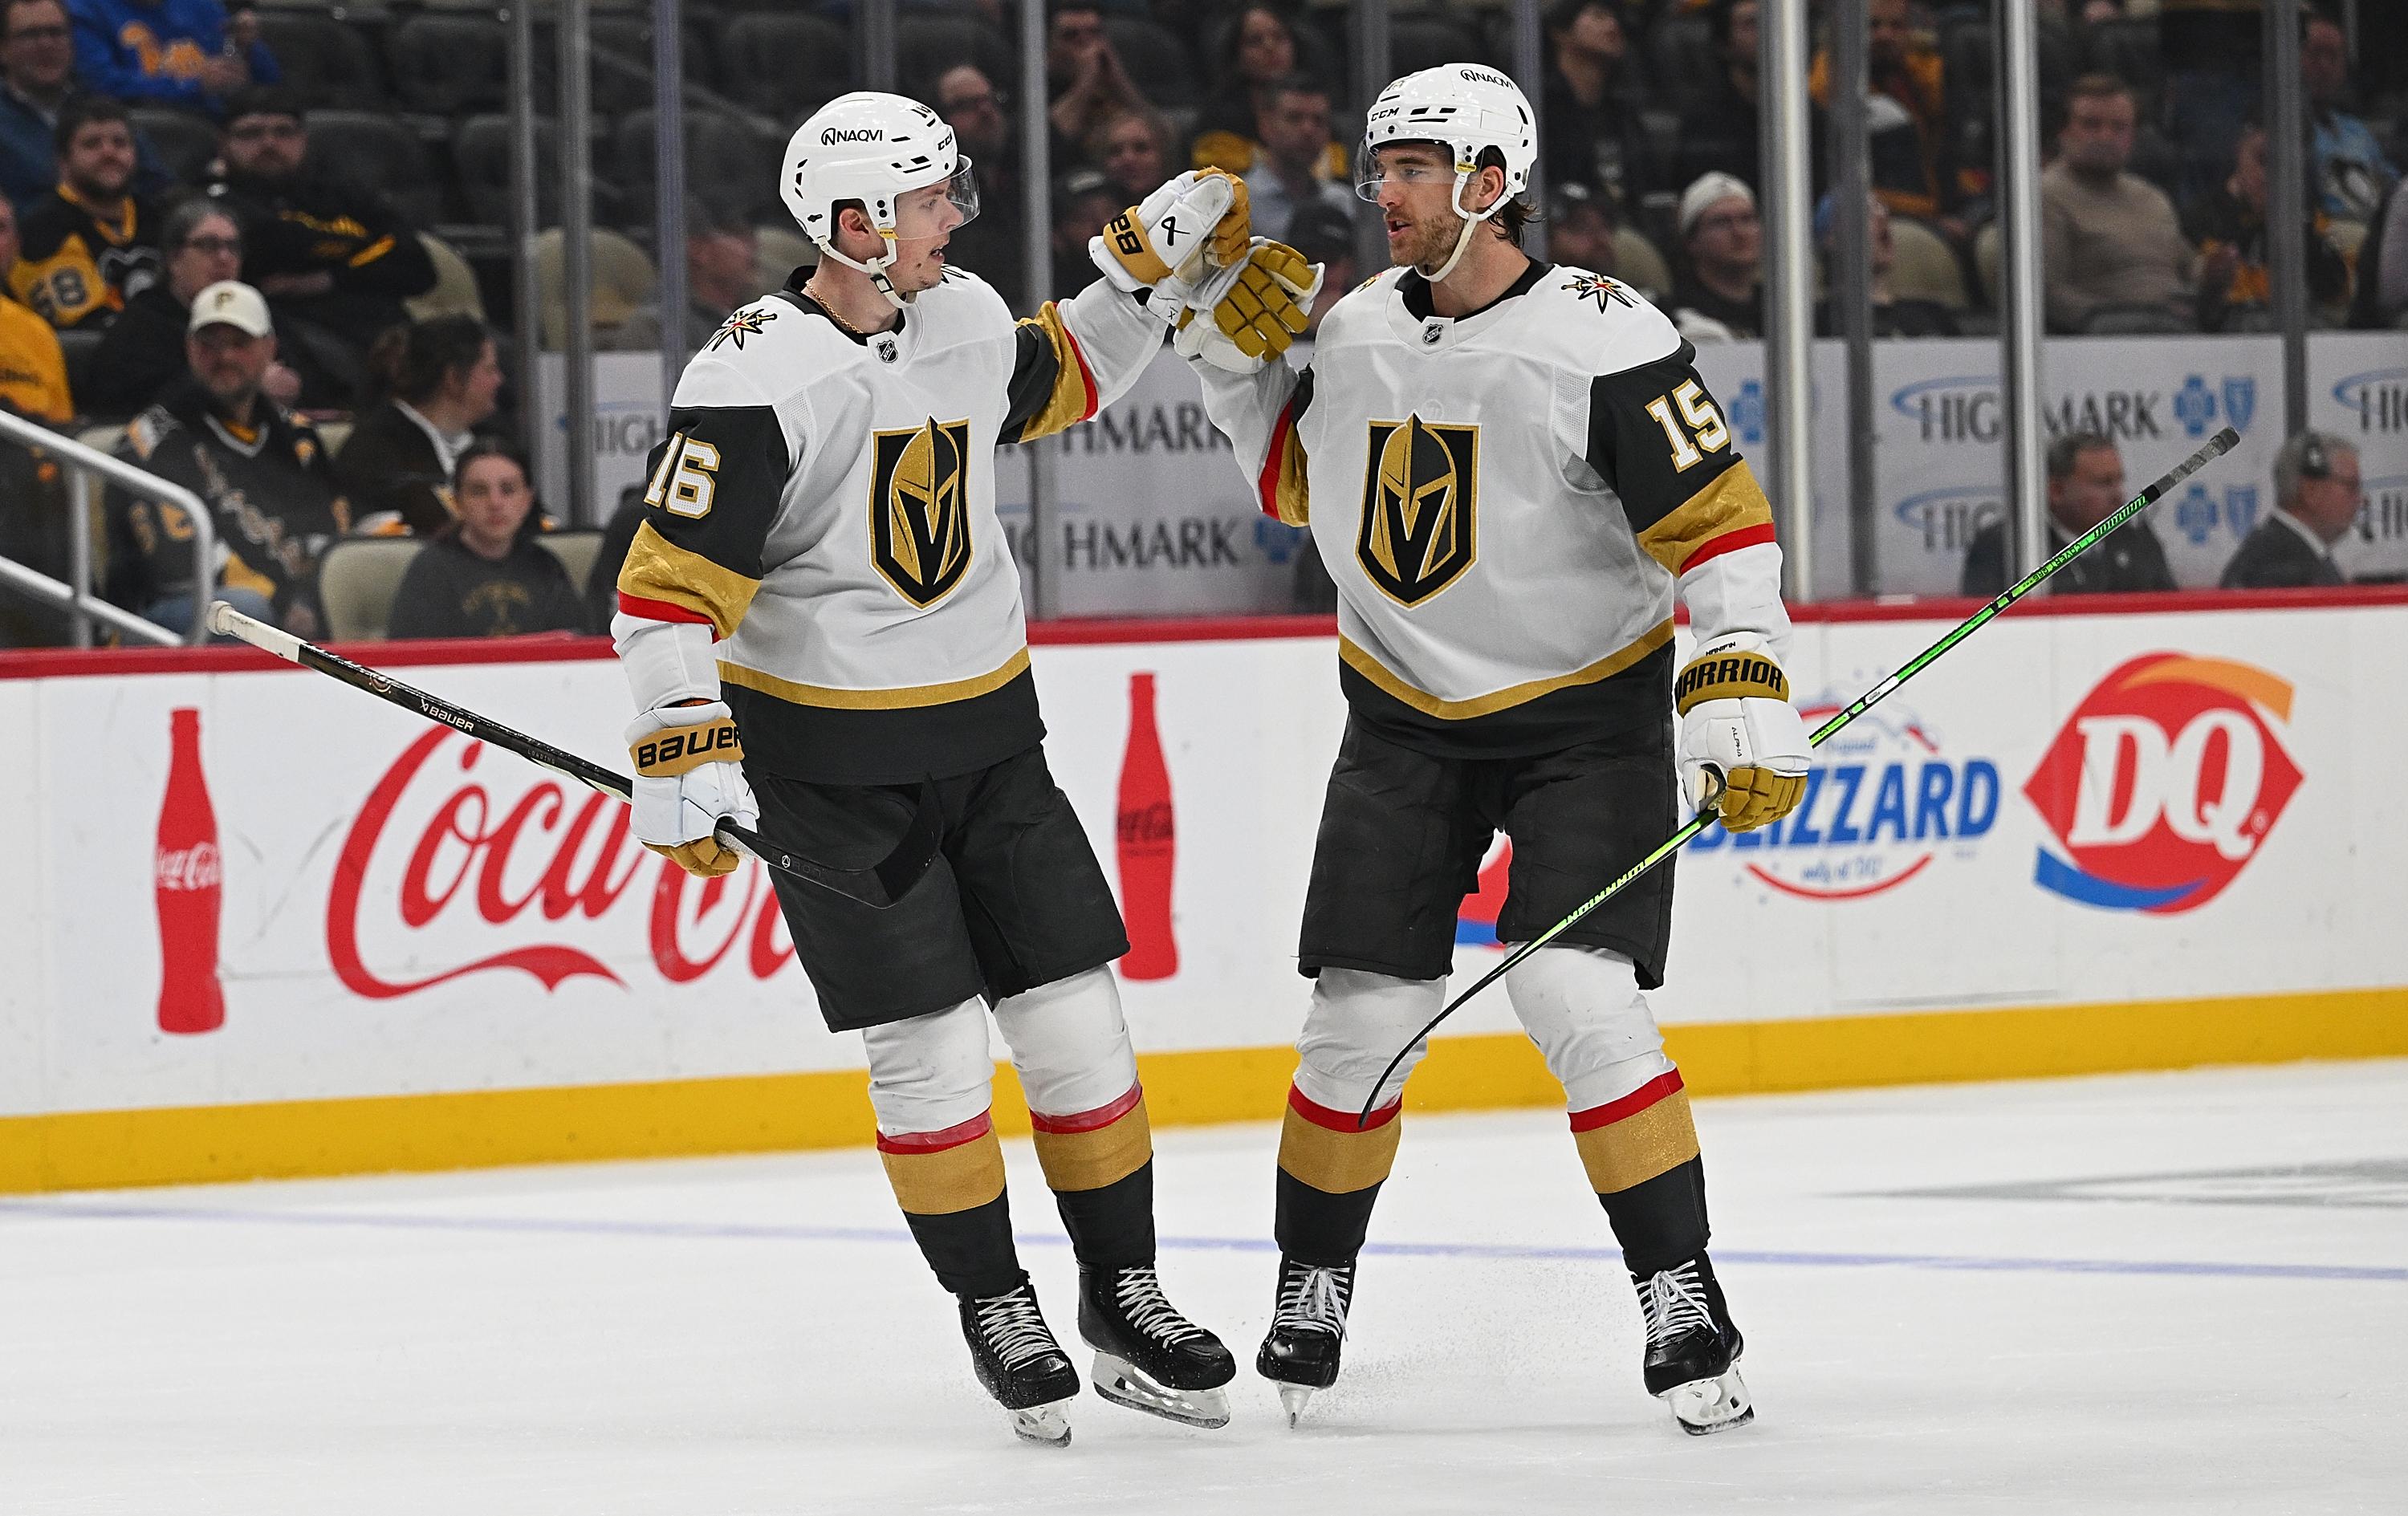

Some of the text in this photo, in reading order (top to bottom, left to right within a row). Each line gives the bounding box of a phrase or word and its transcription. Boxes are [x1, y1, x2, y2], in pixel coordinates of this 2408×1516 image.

[1371, 108, 1400, 121] CCM
[836, 129, 883, 143] NAQVI
[1645, 378, 1731, 473] 15
[644, 432, 721, 519] 16
[1706, 641, 1736, 656] HANIFIN
[429, 706, 475, 732] BAUER
[1731, 726, 1743, 758] ALPHA
[2068, 707, 2265, 861] DQ
